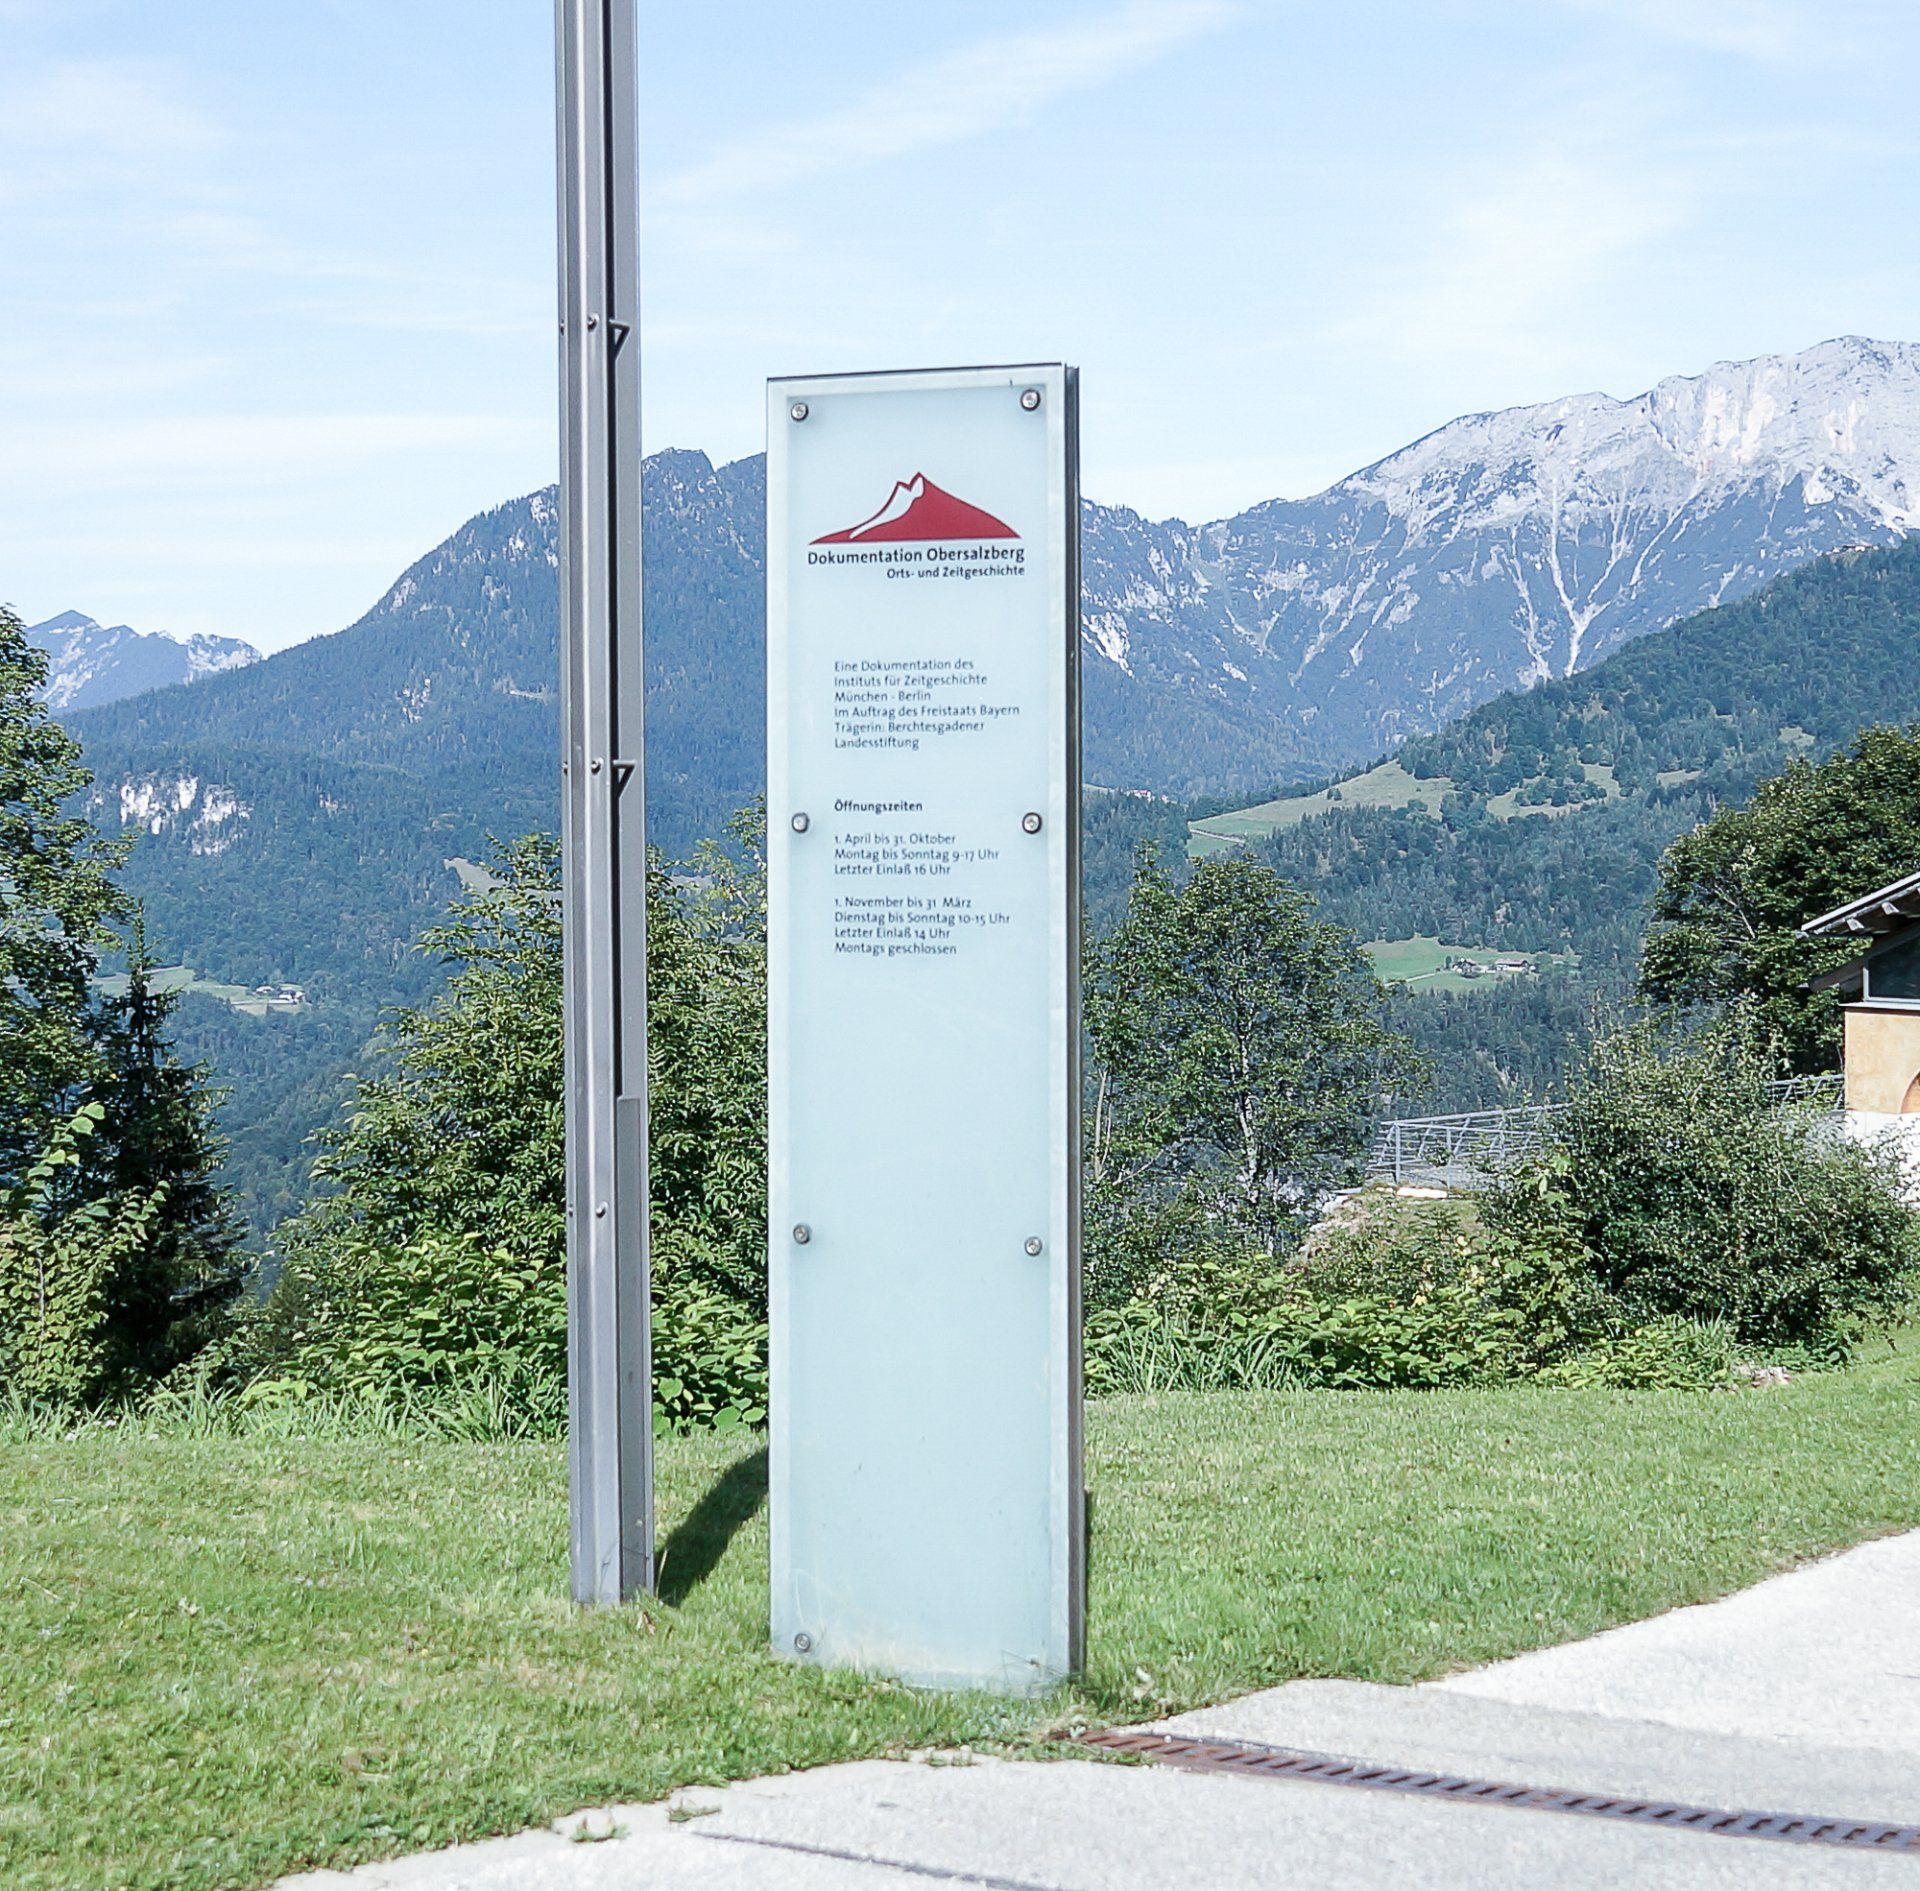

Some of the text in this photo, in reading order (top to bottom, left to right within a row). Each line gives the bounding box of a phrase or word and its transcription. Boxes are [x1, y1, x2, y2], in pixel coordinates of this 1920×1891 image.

[807, 547, 1025, 565] Dokumentation Obersalzberg
[886, 565, 1025, 580] Orts- und Zeitgeschichte
[834, 658, 974, 672] Eine Dokumentation des
[834, 673, 988, 689] Instituts für Zeitgeschichte
[834, 691, 888, 702] München
[898, 690, 931, 701] Berlin
[834, 705, 1020, 720] Im Auftrag des Freistaats Bayern
[888, 720, 985, 735] Berchtesgadener
[834, 736, 920, 751] Landesstiftung
[834, 799, 923, 814] Öffnungszeiten
[844, 833, 871, 846] April
[874, 833, 890, 843] bis
[909, 832, 956, 844] Oktober
[834, 848, 879, 862] Montag
[882, 848, 898, 860] bis
[901, 848, 950, 862] Sonntag
[978, 848, 999, 860] Uhr
[834, 863, 951, 875] Letzter Einlaß 16 Uhr
[845, 897, 903, 908] November
[907, 896, 923, 908] bis
[942, 897, 972, 908] März
[834, 912, 885, 926] Dienstag
[888, 912, 904, 923] bis
[907, 912, 955, 926] Sonntag
[989, 912, 1010, 923] Uhr
[834, 927, 950, 939] Letzter Einlaß 14 Uhr
[834, 942, 957, 956] Montags geschlossen
